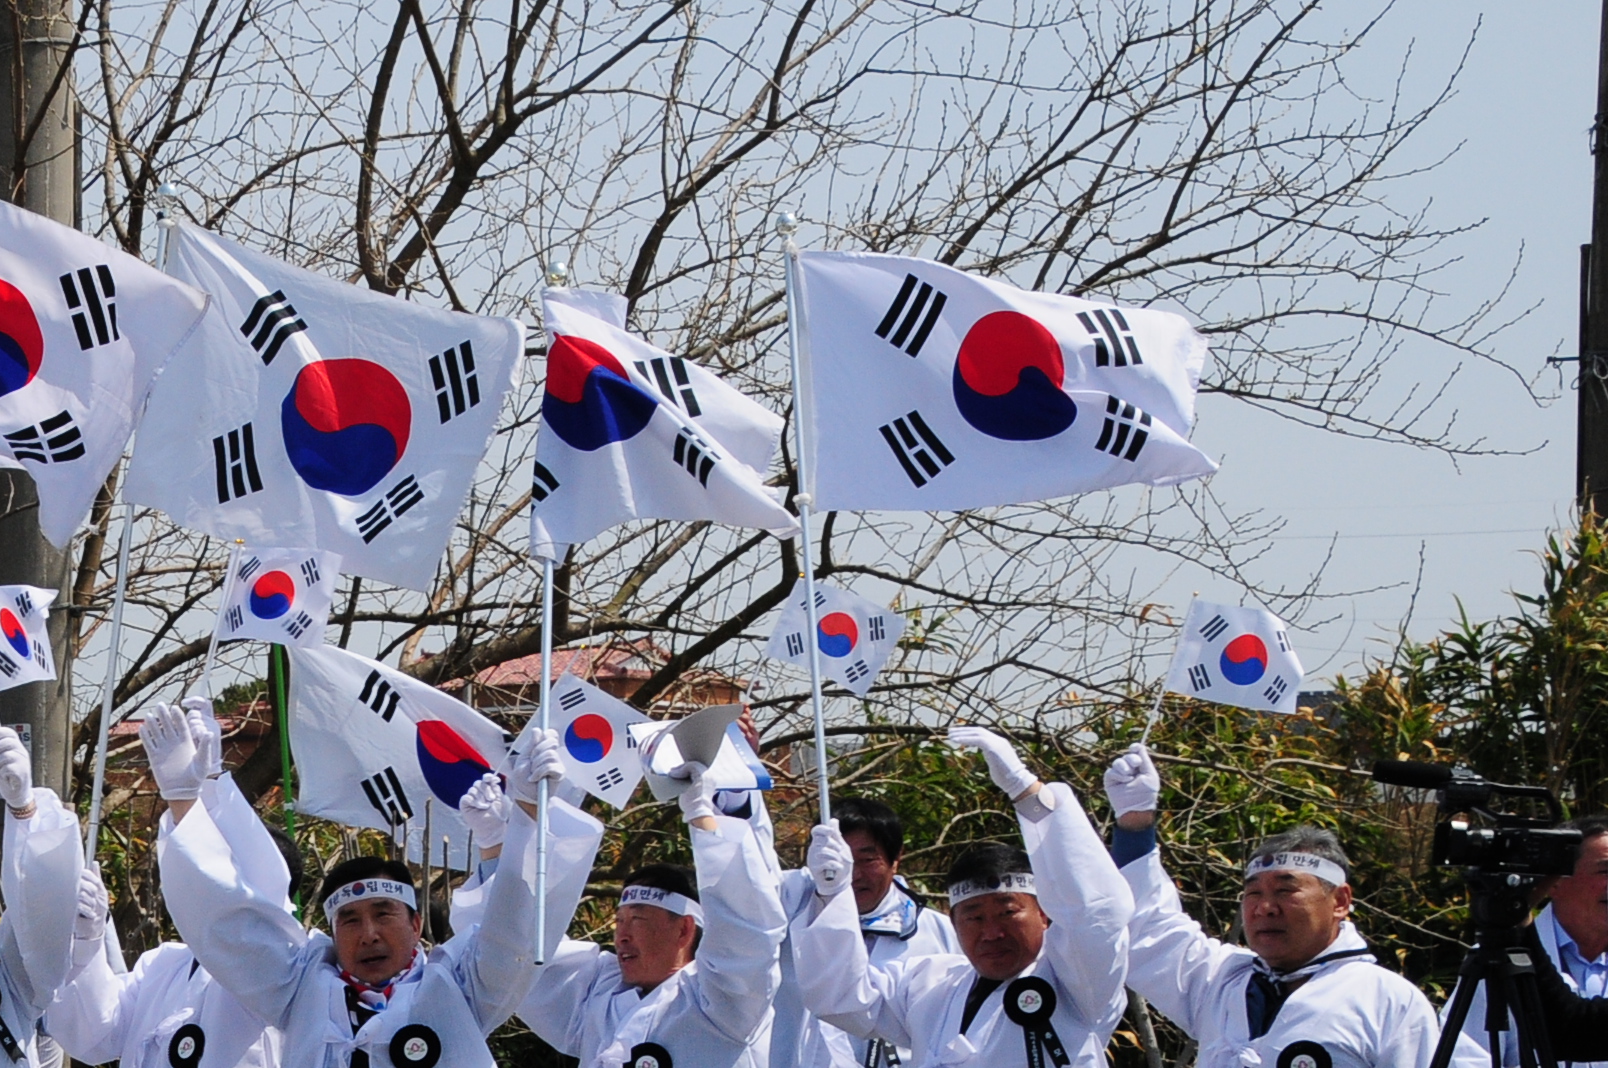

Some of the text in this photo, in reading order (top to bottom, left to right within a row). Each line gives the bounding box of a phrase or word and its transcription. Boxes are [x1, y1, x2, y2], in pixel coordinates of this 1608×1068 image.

[1292, 854, 1321, 869] 만세
[381, 881, 405, 896] 만세
[640, 888, 666, 902] 만세
[952, 881, 972, 897] 대한
